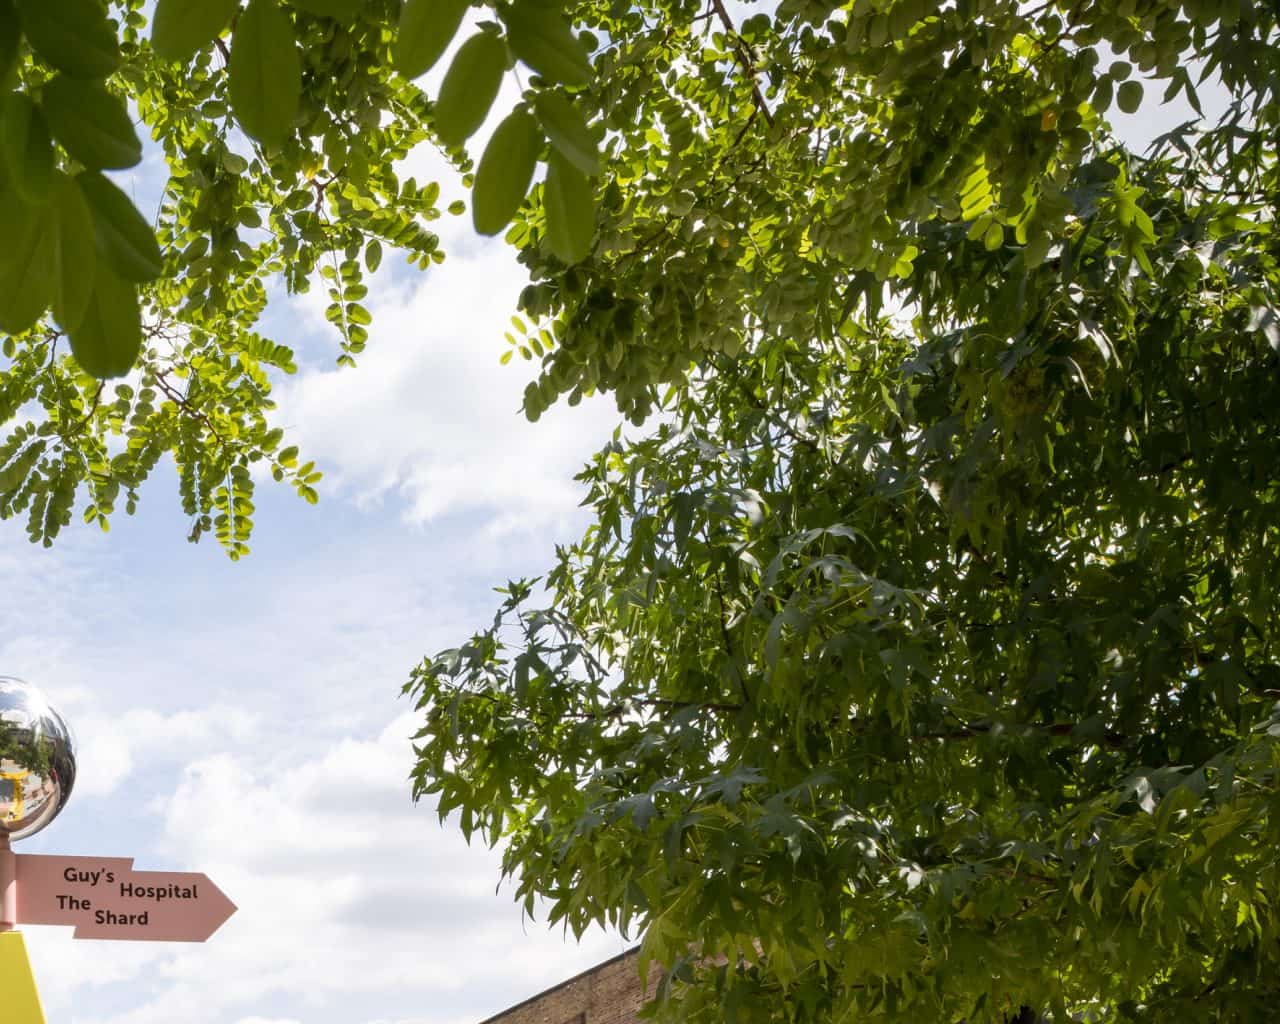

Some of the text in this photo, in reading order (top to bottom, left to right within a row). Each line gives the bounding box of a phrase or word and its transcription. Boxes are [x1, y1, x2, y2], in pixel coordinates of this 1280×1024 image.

[63, 866, 199, 902] Guy's Hospital
[56, 894, 149, 927] The Shard
